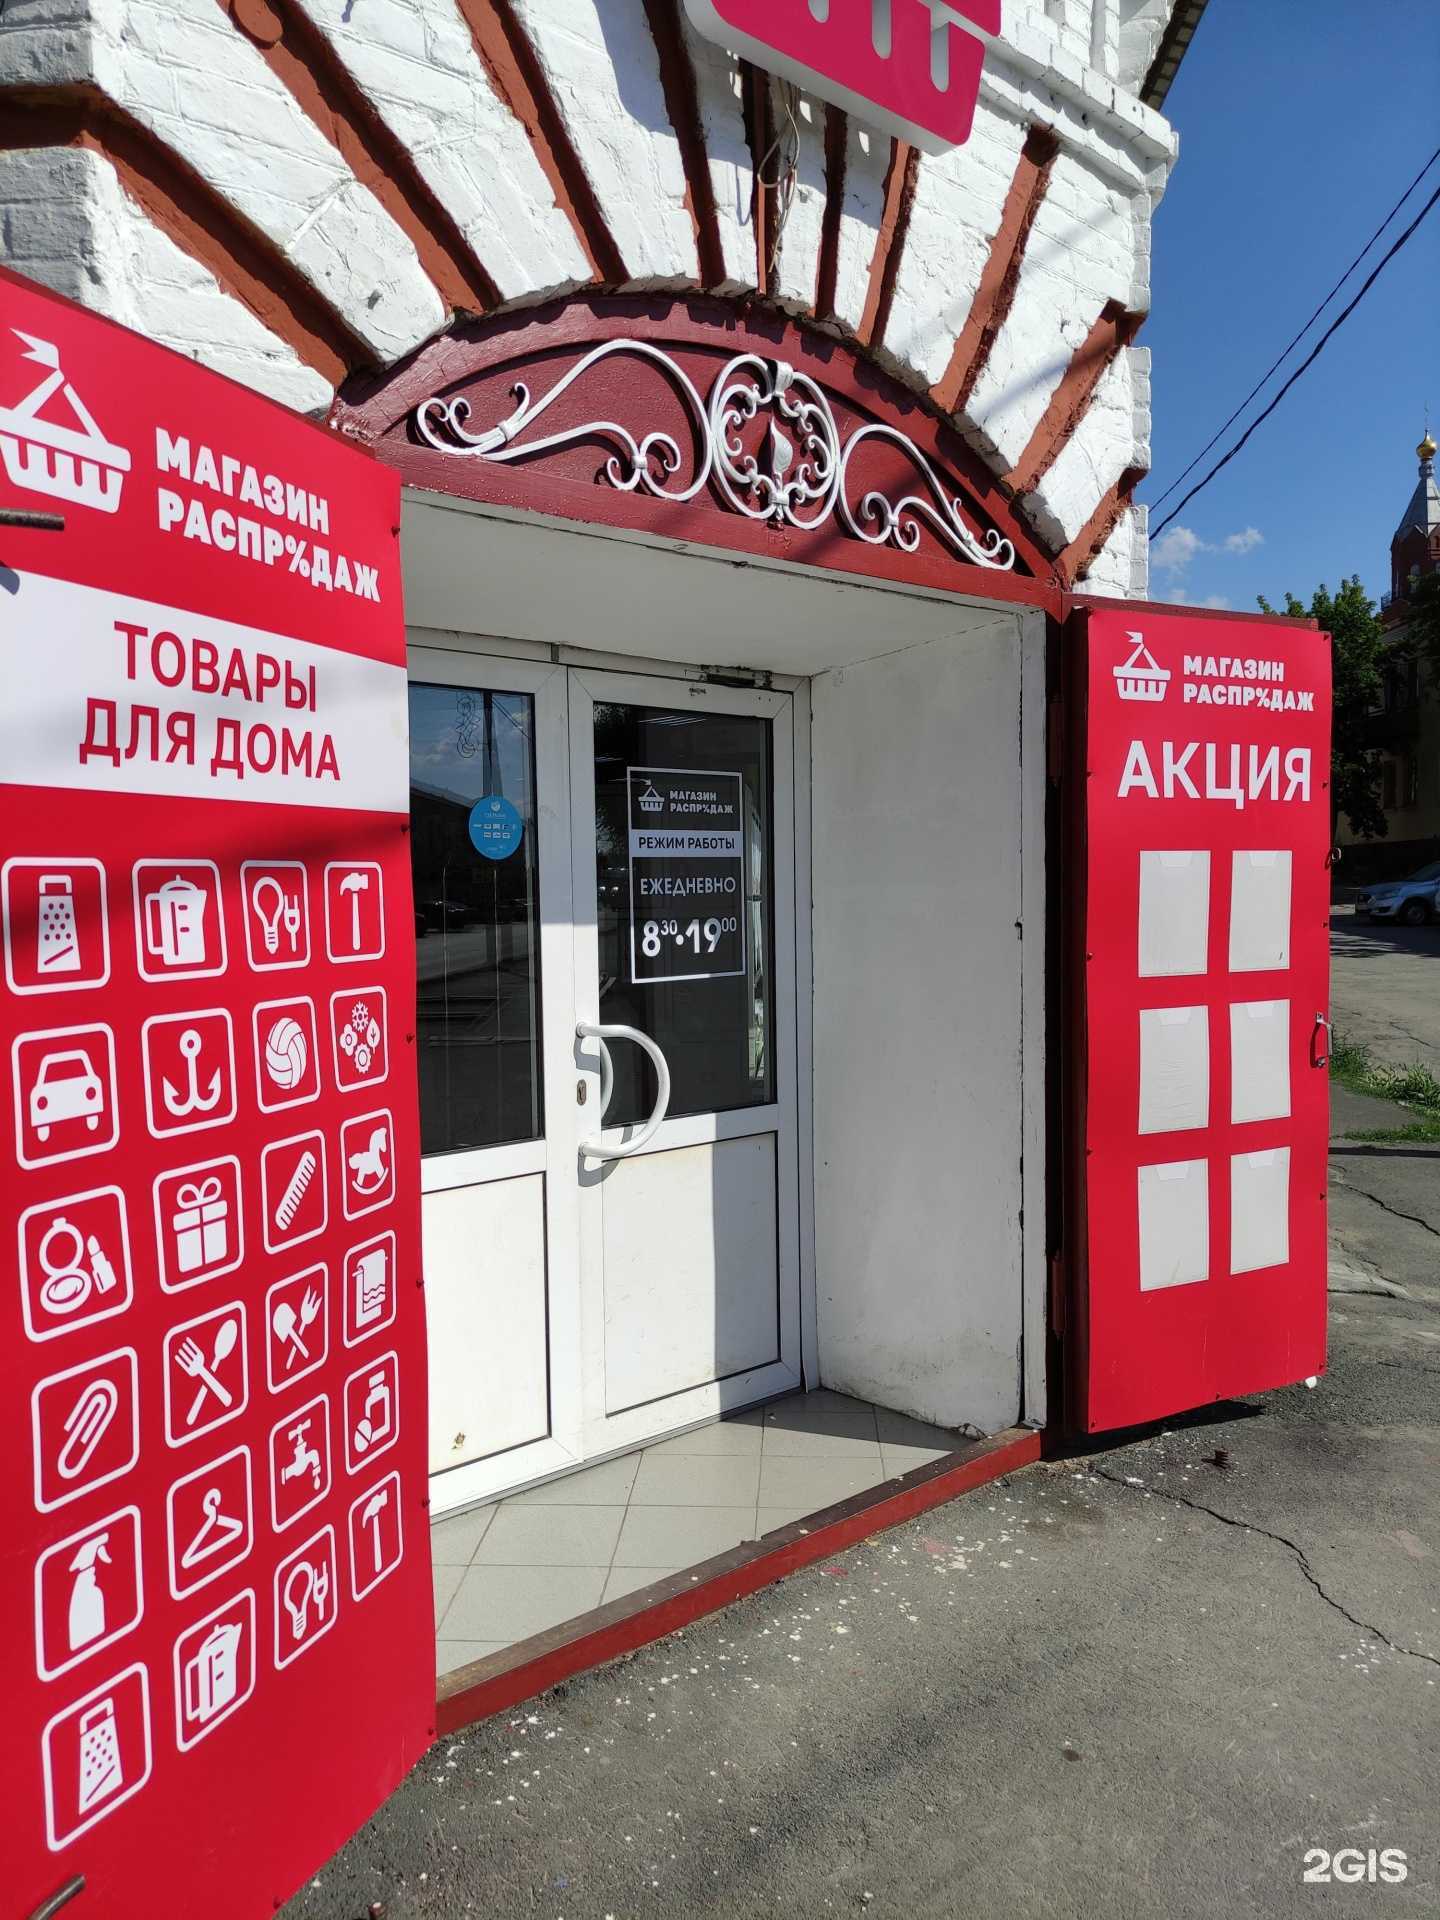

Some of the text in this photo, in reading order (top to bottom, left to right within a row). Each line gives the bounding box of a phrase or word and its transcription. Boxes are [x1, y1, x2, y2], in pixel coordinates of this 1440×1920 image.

[155, 427, 330, 536] МАГАЗИН
[157, 488, 382, 603] РАСПР%ДАЖ
[113, 620, 317, 713] ТОВАРЫ
[1183, 654, 1285, 682] МАГАЗИН
[1183, 683, 1315, 712] РАСПР%ДАЖ
[79, 697, 341, 781] ДЛЯ ДОМА
[1117, 740, 1312, 810] АКЦИЯ
[669, 790, 717, 801] МАГАЗИН
[669, 802, 734, 814] РАСПР%ДАЖ
[638, 836, 735, 849] РЕЖИМ РАБОТЫ
[640, 876, 736, 897] ЕЖЕДНЕВНО
